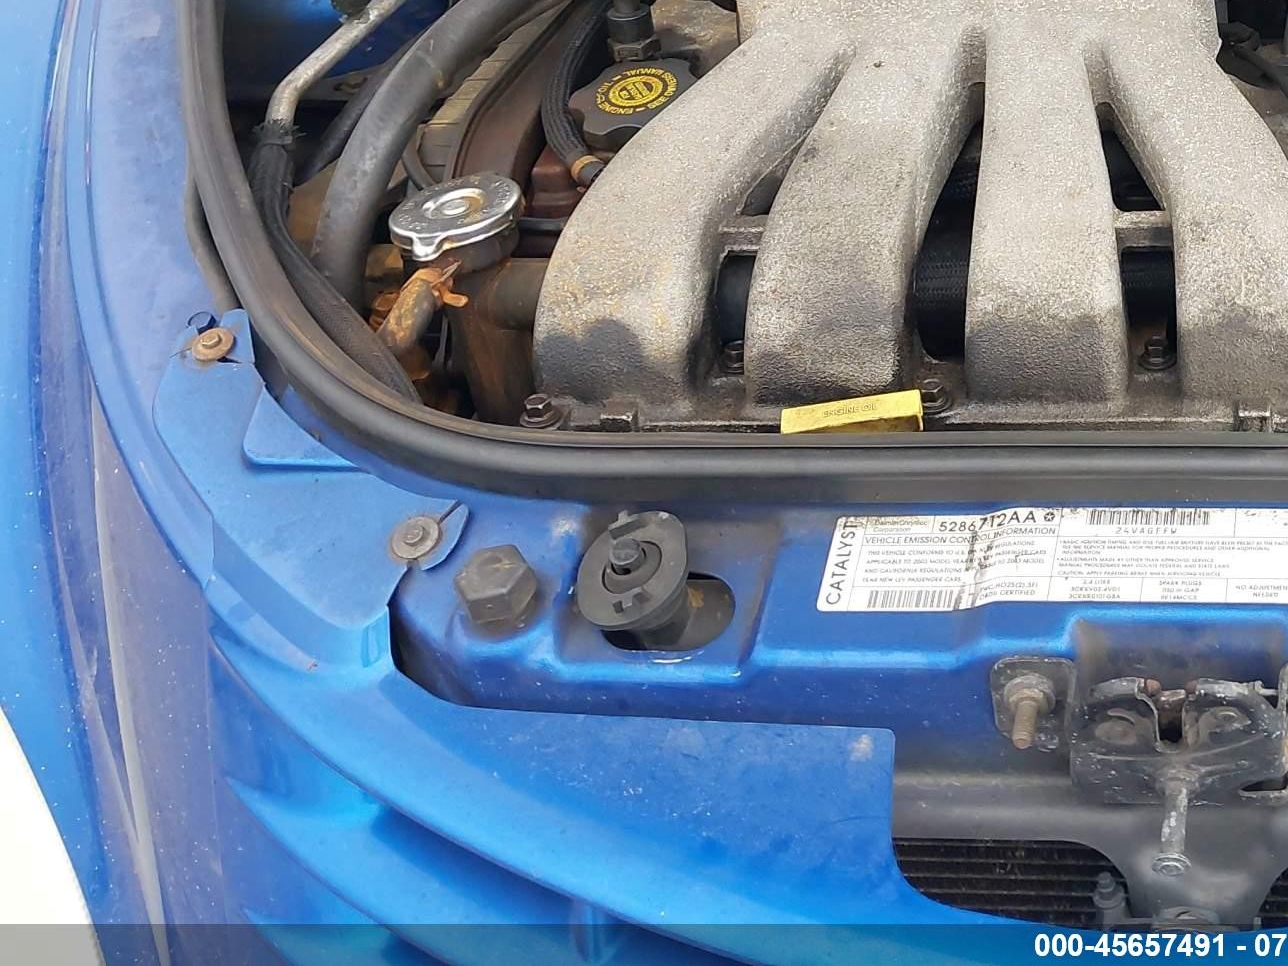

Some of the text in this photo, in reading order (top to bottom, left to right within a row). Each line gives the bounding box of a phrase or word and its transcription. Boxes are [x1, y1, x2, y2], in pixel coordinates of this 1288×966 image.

[864, 527, 1056, 545] VEHICLE EMISSION CONTROL INFORMATION
[825, 520, 859, 605] CATALYST
